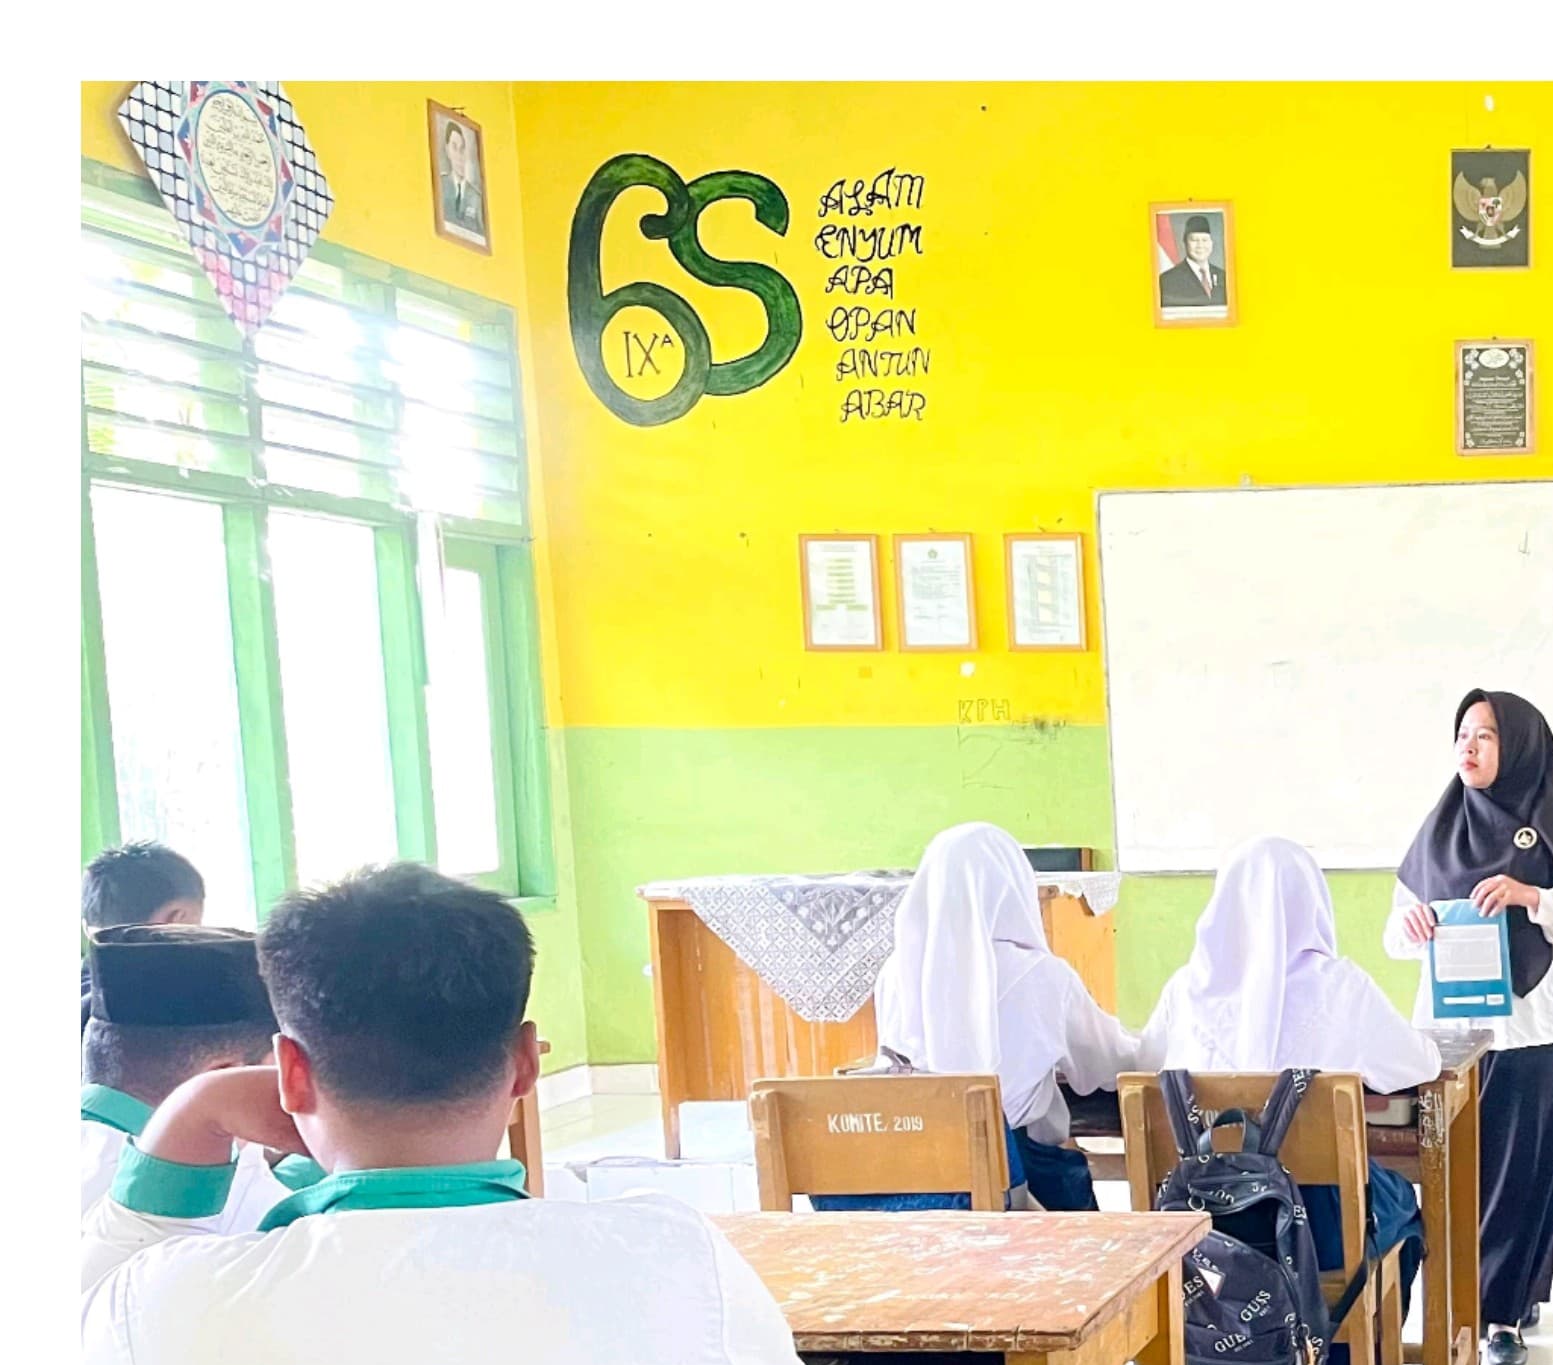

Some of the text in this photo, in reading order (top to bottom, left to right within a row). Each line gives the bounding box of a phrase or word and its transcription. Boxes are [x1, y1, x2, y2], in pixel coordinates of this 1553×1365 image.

[814, 223, 923, 262] ENYUM
[825, 265, 894, 300] APA
[826, 306, 916, 342] OPAN
[836, 347, 931, 382] ANTUN
[841, 388, 927, 423] ABAR
